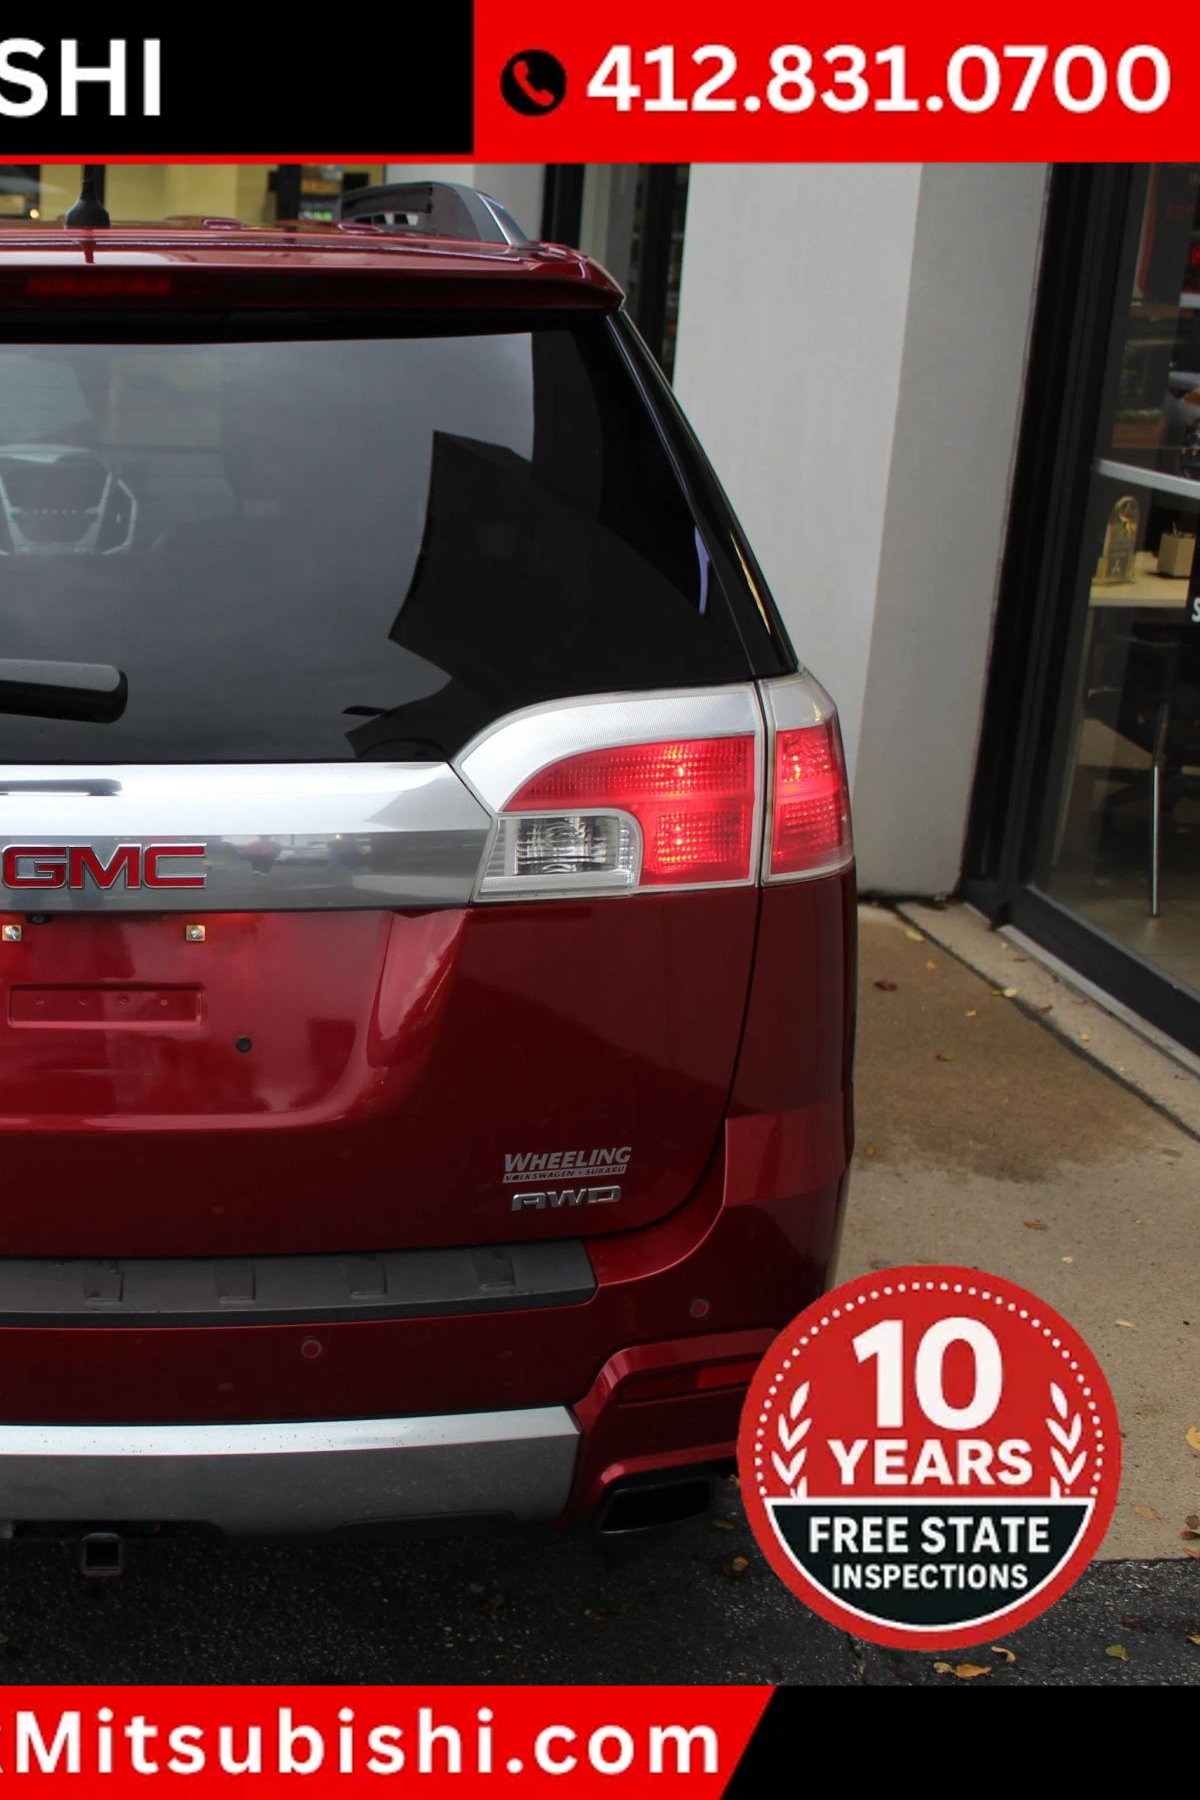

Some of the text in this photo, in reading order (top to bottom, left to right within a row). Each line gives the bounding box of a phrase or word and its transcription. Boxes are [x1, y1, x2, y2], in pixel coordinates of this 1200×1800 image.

[1, 843, 207, 889] GMC
[504, 1146, 632, 1172] WHEELING
[504, 1165, 625, 1182] VOLKSWAGEN SUBARU
[511, 1185, 621, 1212] AWD
